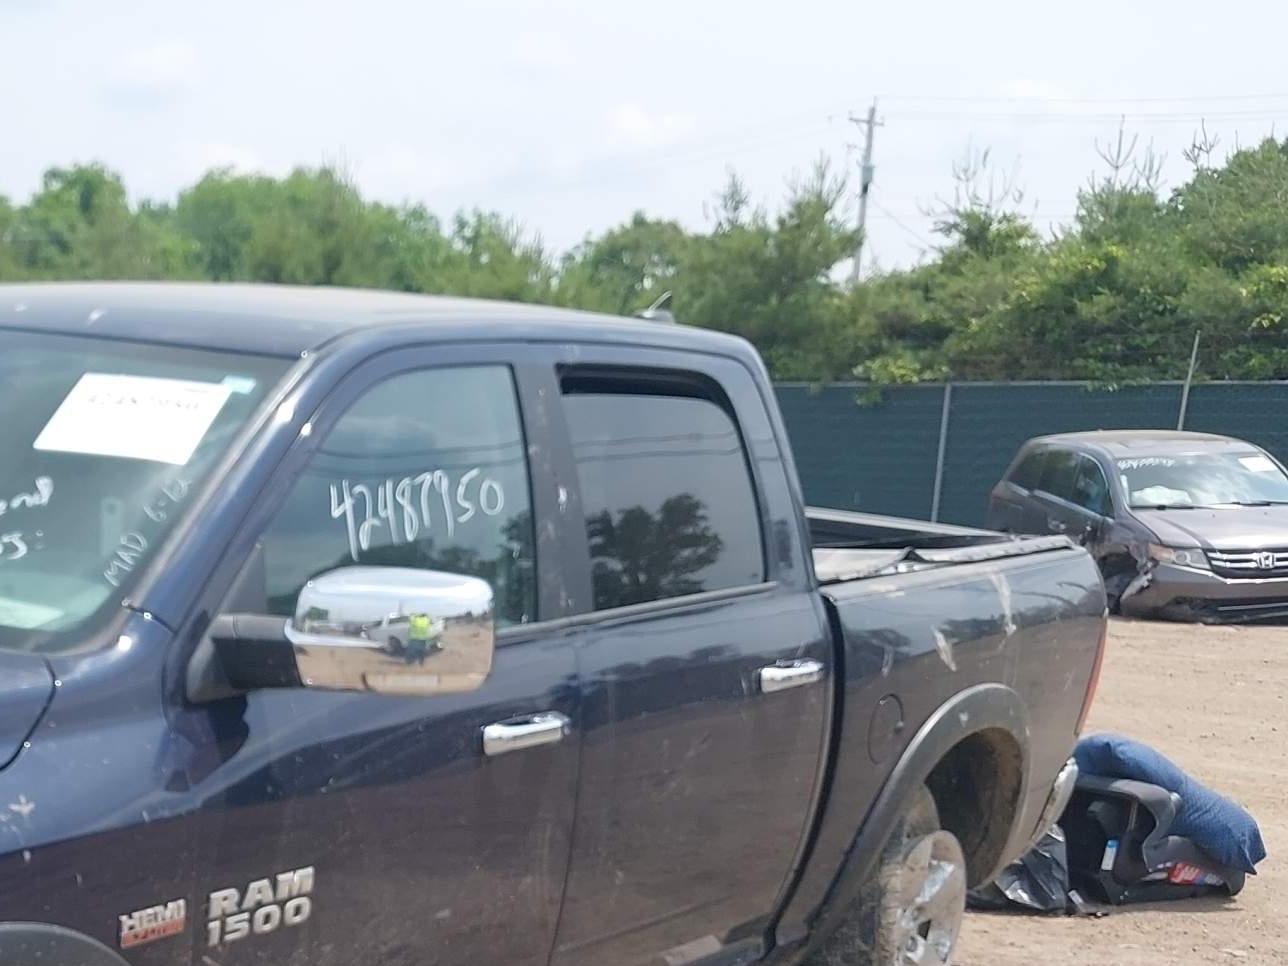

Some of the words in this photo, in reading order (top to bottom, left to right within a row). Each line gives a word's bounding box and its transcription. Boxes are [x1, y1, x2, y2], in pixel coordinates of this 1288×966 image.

[330, 468, 505, 561] 42487950
[208, 866, 315, 919] RAM
[118, 899, 185, 940] HEMI
[208, 896, 311, 946] 1500
